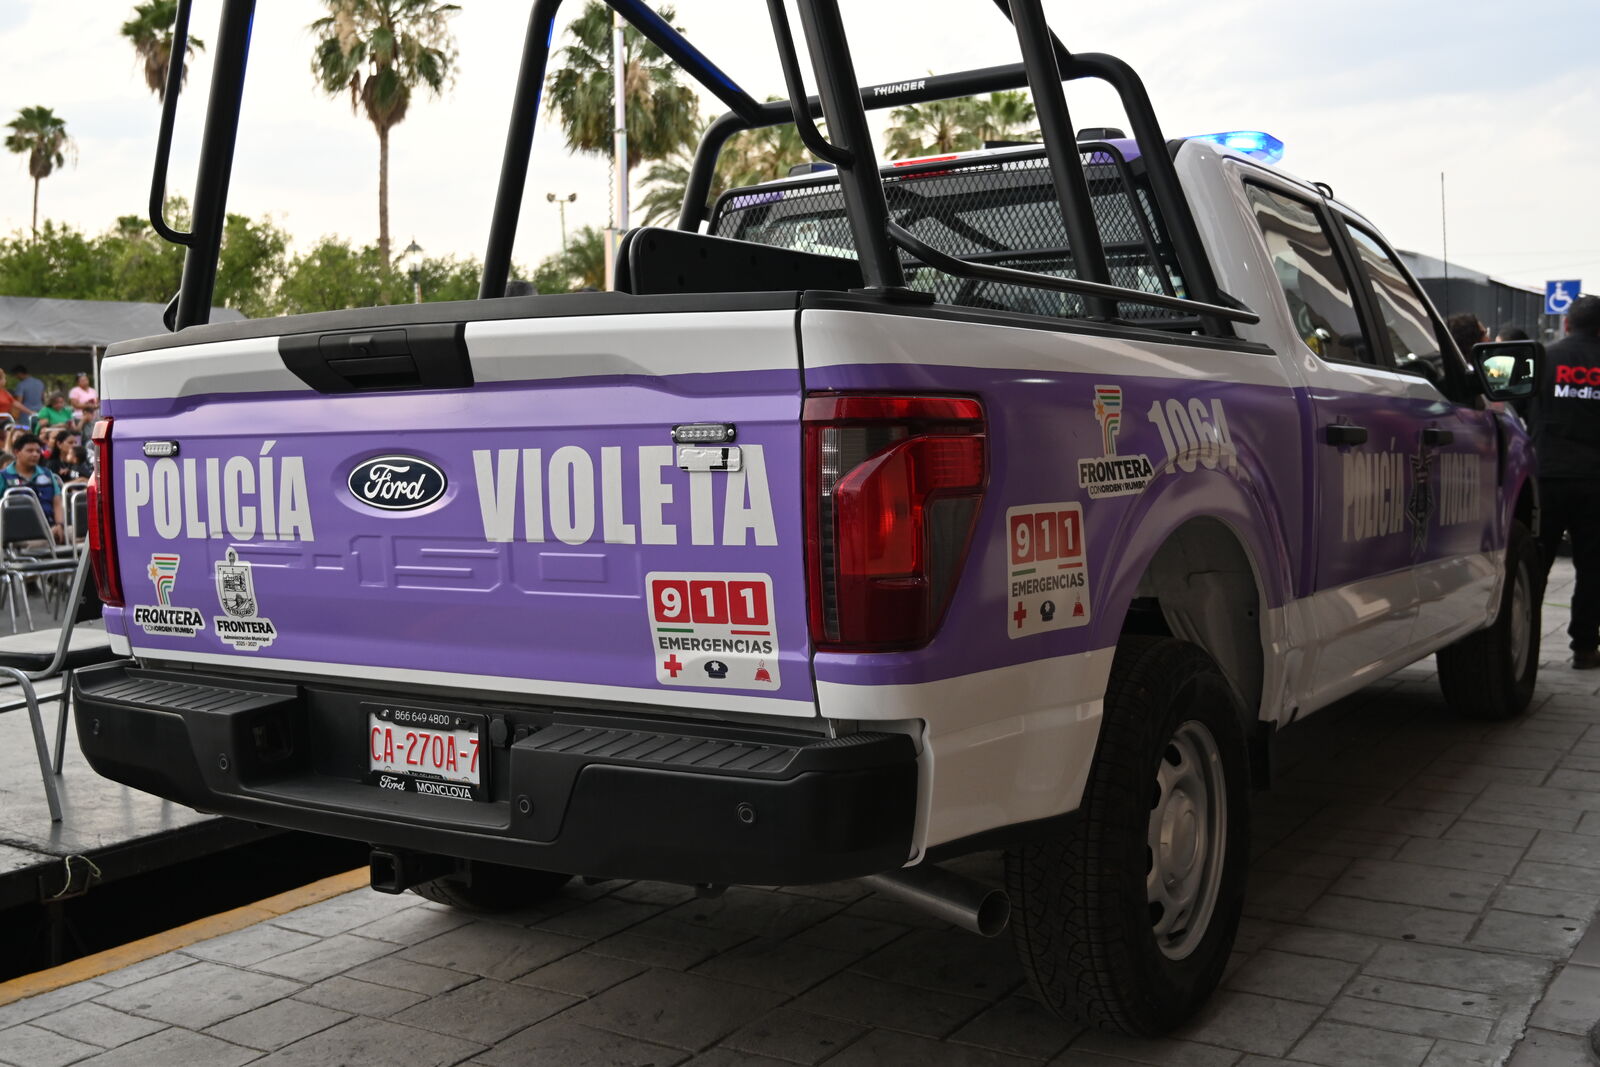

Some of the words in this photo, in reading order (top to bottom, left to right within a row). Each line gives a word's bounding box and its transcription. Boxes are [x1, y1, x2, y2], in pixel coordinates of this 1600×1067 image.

[873, 80, 926, 97] THUNDER
[363, 464, 426, 501] Ford
[1079, 458, 1153, 484] FRONTERA
[124, 440, 315, 542] POLICÍA
[472, 444, 779, 546] VIOLETA
[1342, 437, 1404, 542] POLICÍA
[1015, 517, 1074, 558] 911
[1011, 572, 1085, 597] EMERGENCIAS
[660, 586, 756, 620] 911
[135, 607, 203, 627] FRONTERA
[216, 620, 274, 634] FRONTERA
[658, 636, 773, 655] EMERGENCIAS
[394, 710, 411, 721] 866
[411, 712, 427, 723] 649
[428, 714, 450, 725] 4800
[370, 727, 480, 774] CA-270A-7
[379, 775, 406, 791] Ford
[416, 781, 472, 799] MONCLOVA
